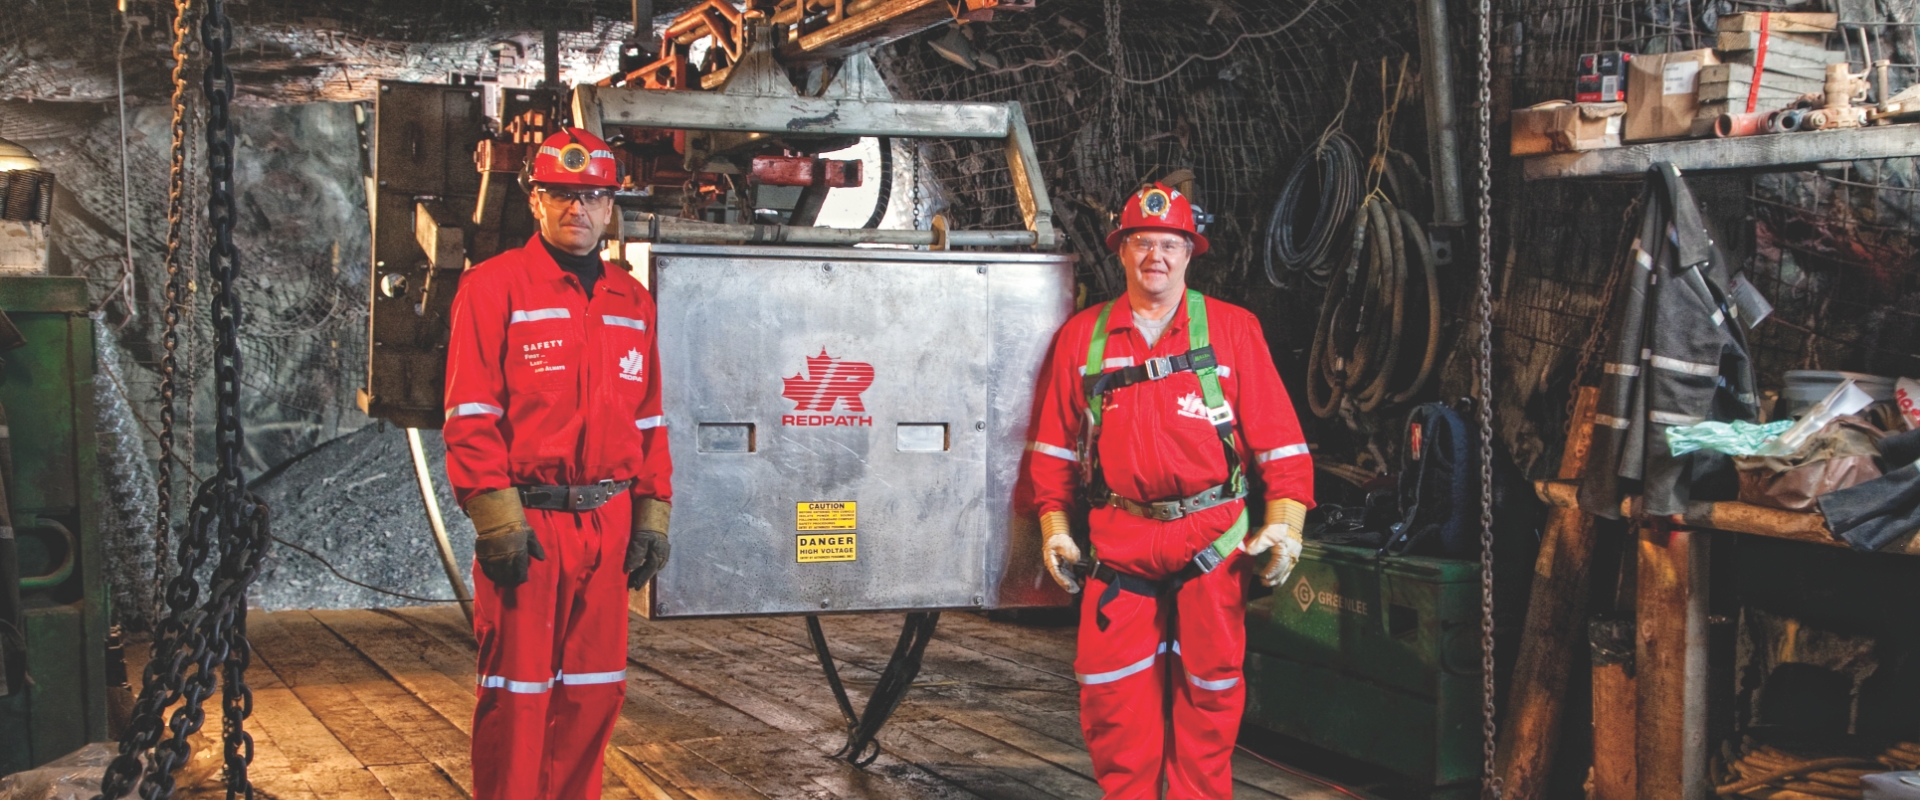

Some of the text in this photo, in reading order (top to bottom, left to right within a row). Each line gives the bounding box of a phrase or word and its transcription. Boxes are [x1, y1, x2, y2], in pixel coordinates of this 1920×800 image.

[523, 340, 563, 352] SAFETY
[619, 373, 643, 383] REDPA
[782, 415, 872, 426] REDPATH
[800, 537, 853, 546] DANGER
[1318, 591, 1368, 616] GREENLEE
